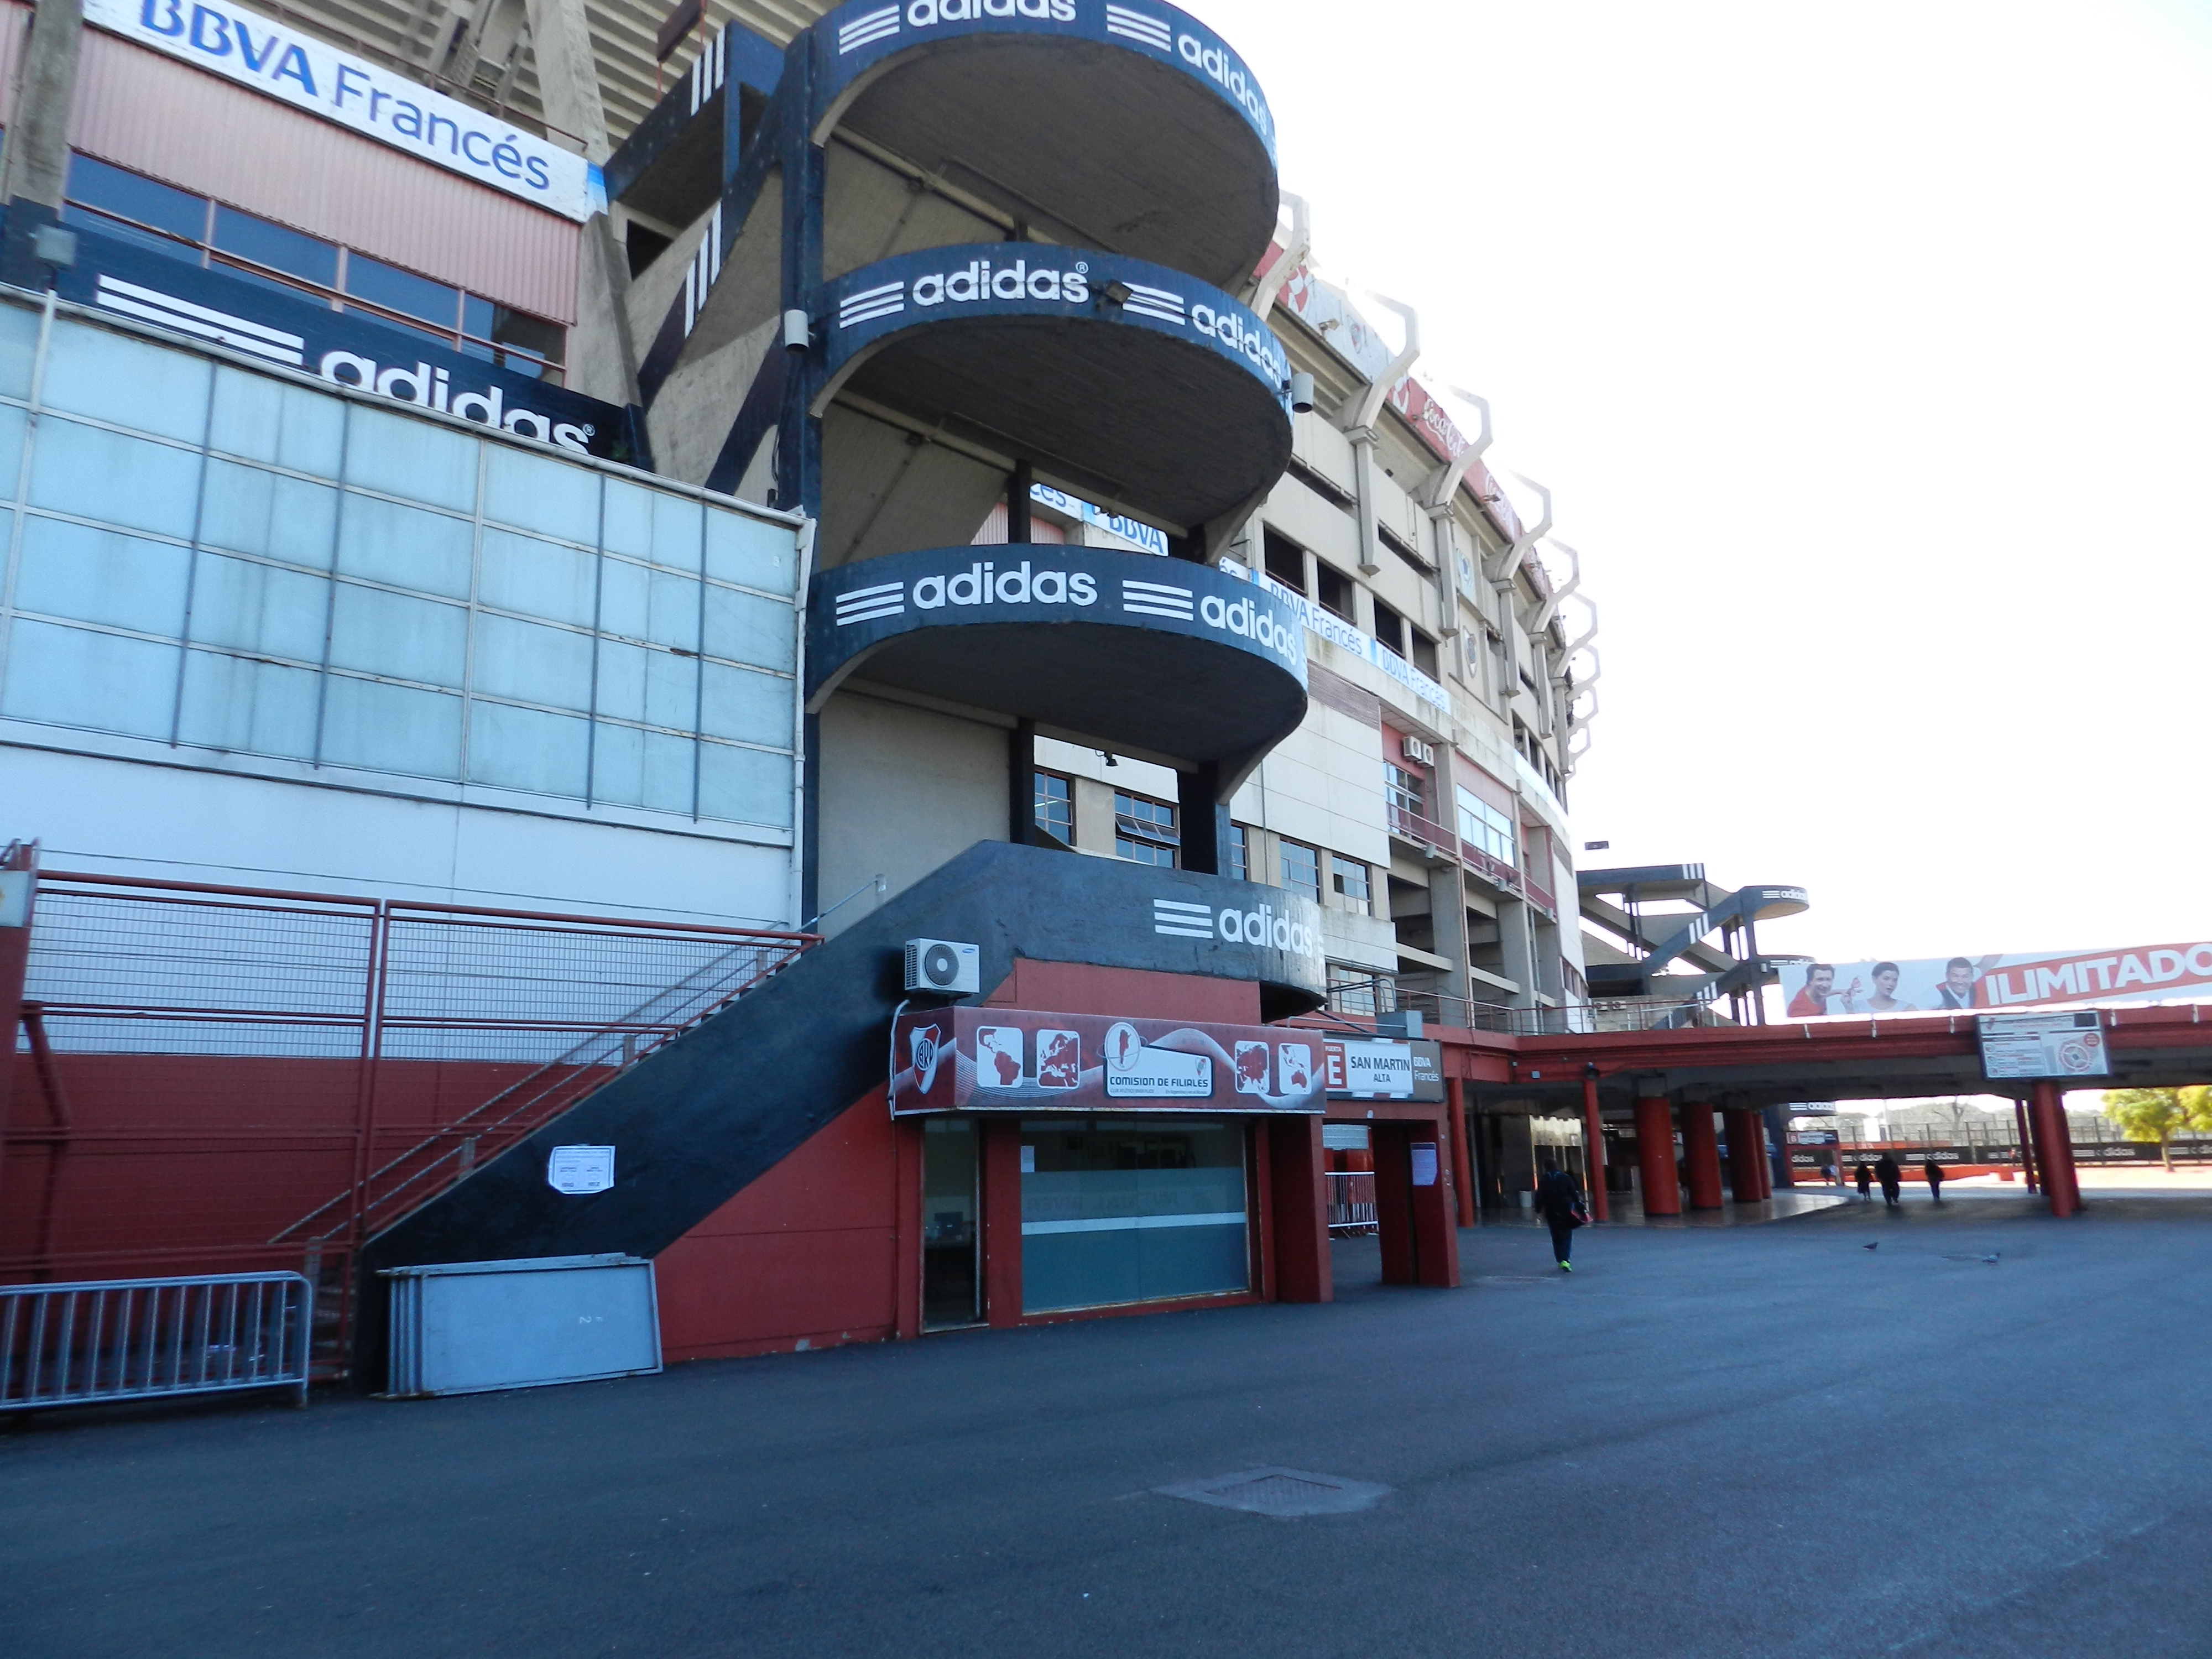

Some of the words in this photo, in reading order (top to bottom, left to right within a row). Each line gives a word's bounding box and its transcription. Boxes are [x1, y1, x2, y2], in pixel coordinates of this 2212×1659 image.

[140, 0, 318, 97] BBVA
[334, 63, 550, 190] Francés
[1178, 34, 1267, 135] adidas
[1192, 304, 1282, 389] adidas
[913, 561, 1098, 609] adidas
[1201, 596, 1297, 665] adidas
[1313, 604, 1363, 655] Francés
[1382, 649, 1410, 687] BBVA
[1410, 660, 1446, 709] Francés
[1219, 904, 1313, 958] adidas
[1985, 943, 2212, 1005] ILIMITADO
[1110, 1077, 1155, 1086] COMISION
[1158, 1078, 1169, 1087] DE
[1171, 1079, 1208, 1088] FILIALES
[1328, 1055, 1342, 1084] E
[1351, 1056, 1371, 1070] SAN
[1374, 1057, 1410, 1071] MARTIN
[1373, 1073, 1391, 1082] ALTA
[1413, 1057, 1431, 1067] BBVA
[1413, 1070, 1439, 1081] Francés
[1791, 1154, 1814, 1162] didas
